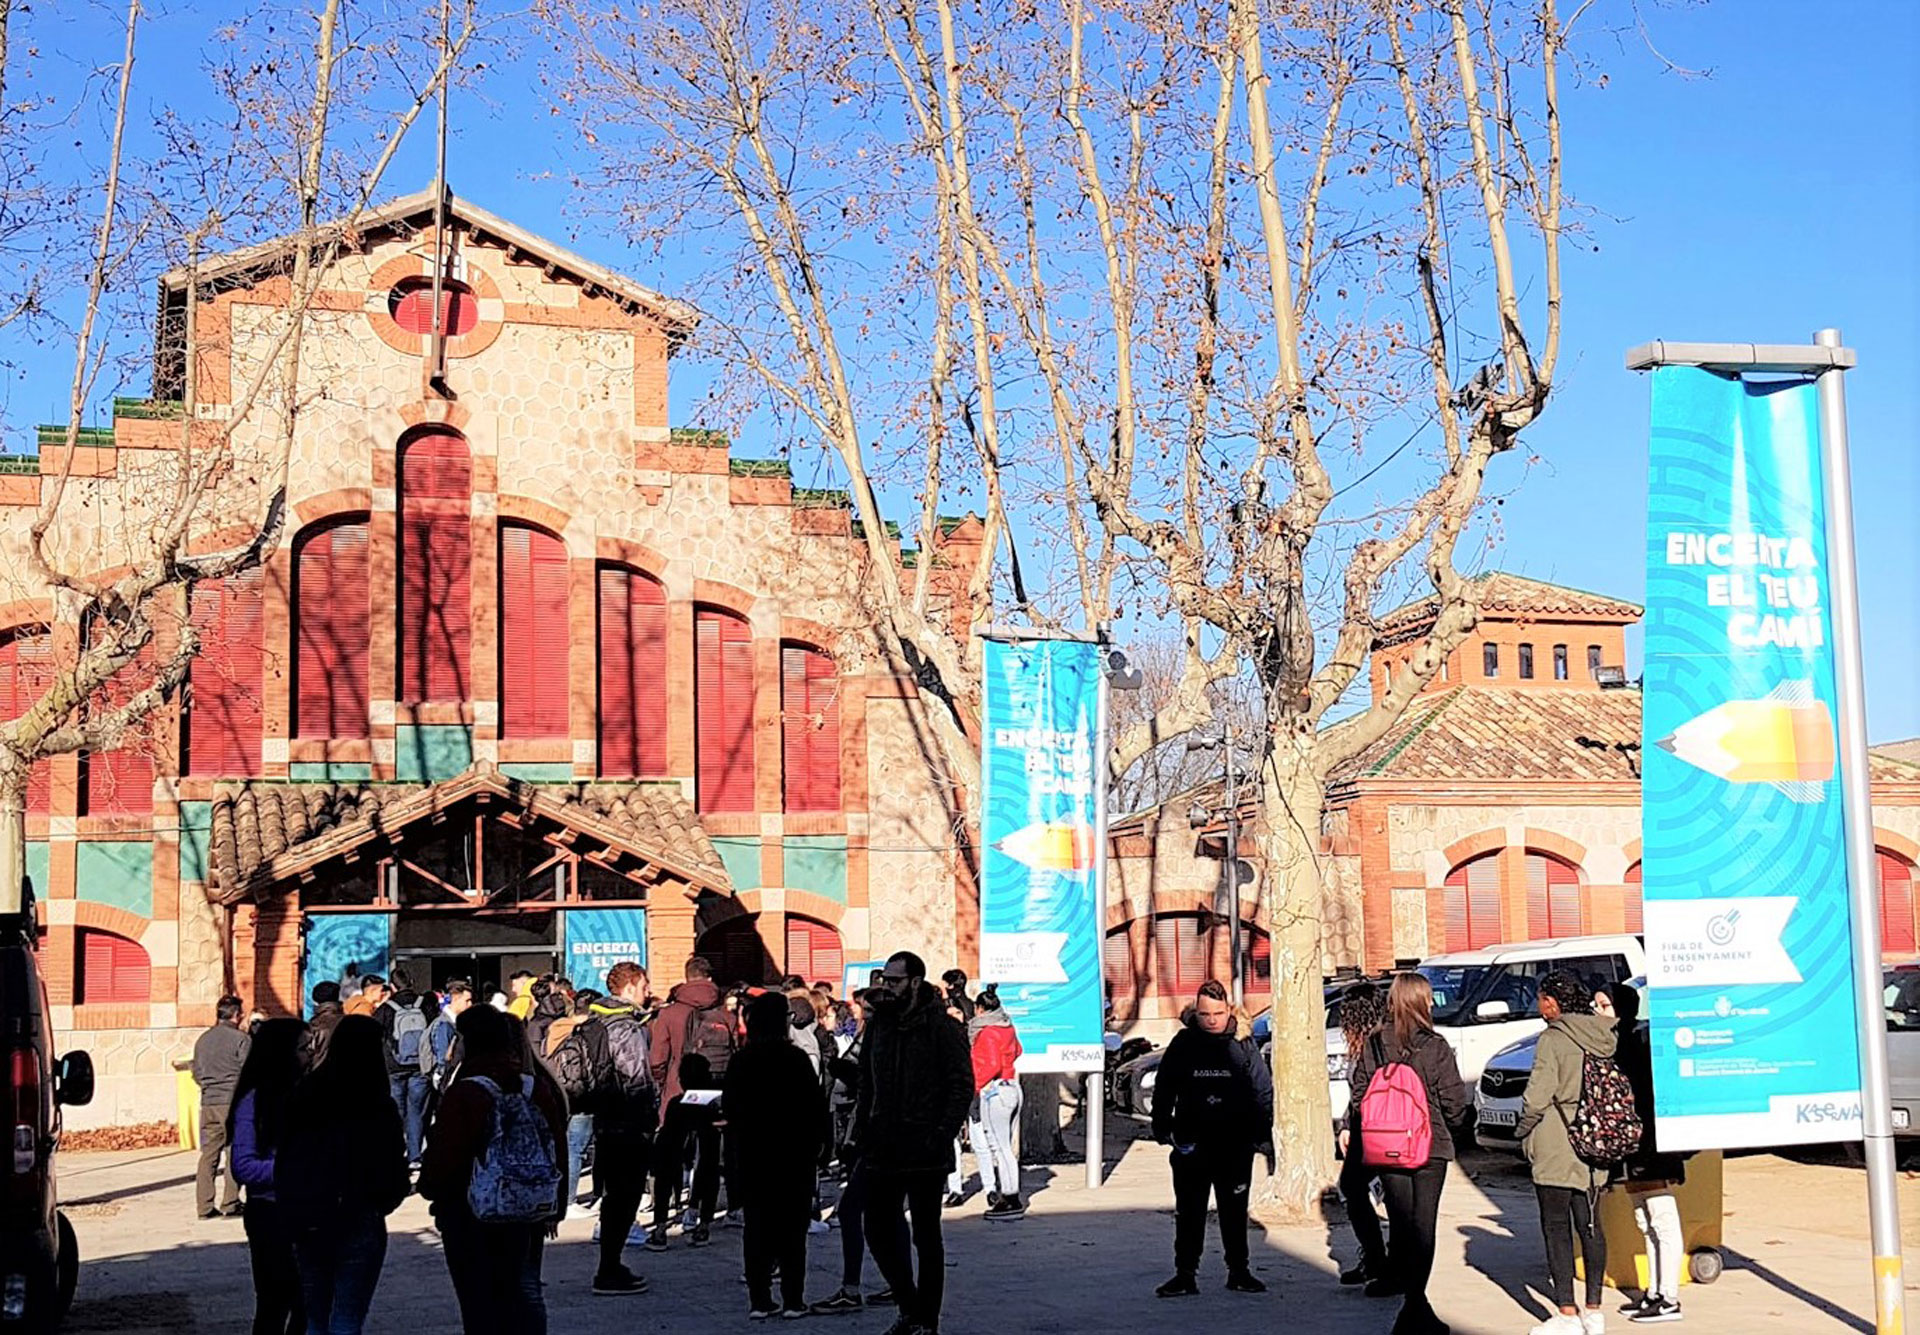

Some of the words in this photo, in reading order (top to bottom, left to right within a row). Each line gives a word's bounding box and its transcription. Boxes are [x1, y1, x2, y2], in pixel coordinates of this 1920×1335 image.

[1707, 574, 1755, 606] EL
[1759, 574, 1818, 609] TEU
[1726, 607, 1823, 648] CAMÍ
[573, 942, 640, 954] ENCERTA
[1662, 942, 1686, 951] FIRA
[1689, 942, 1703, 950] DE
[592, 956, 609, 967] EL
